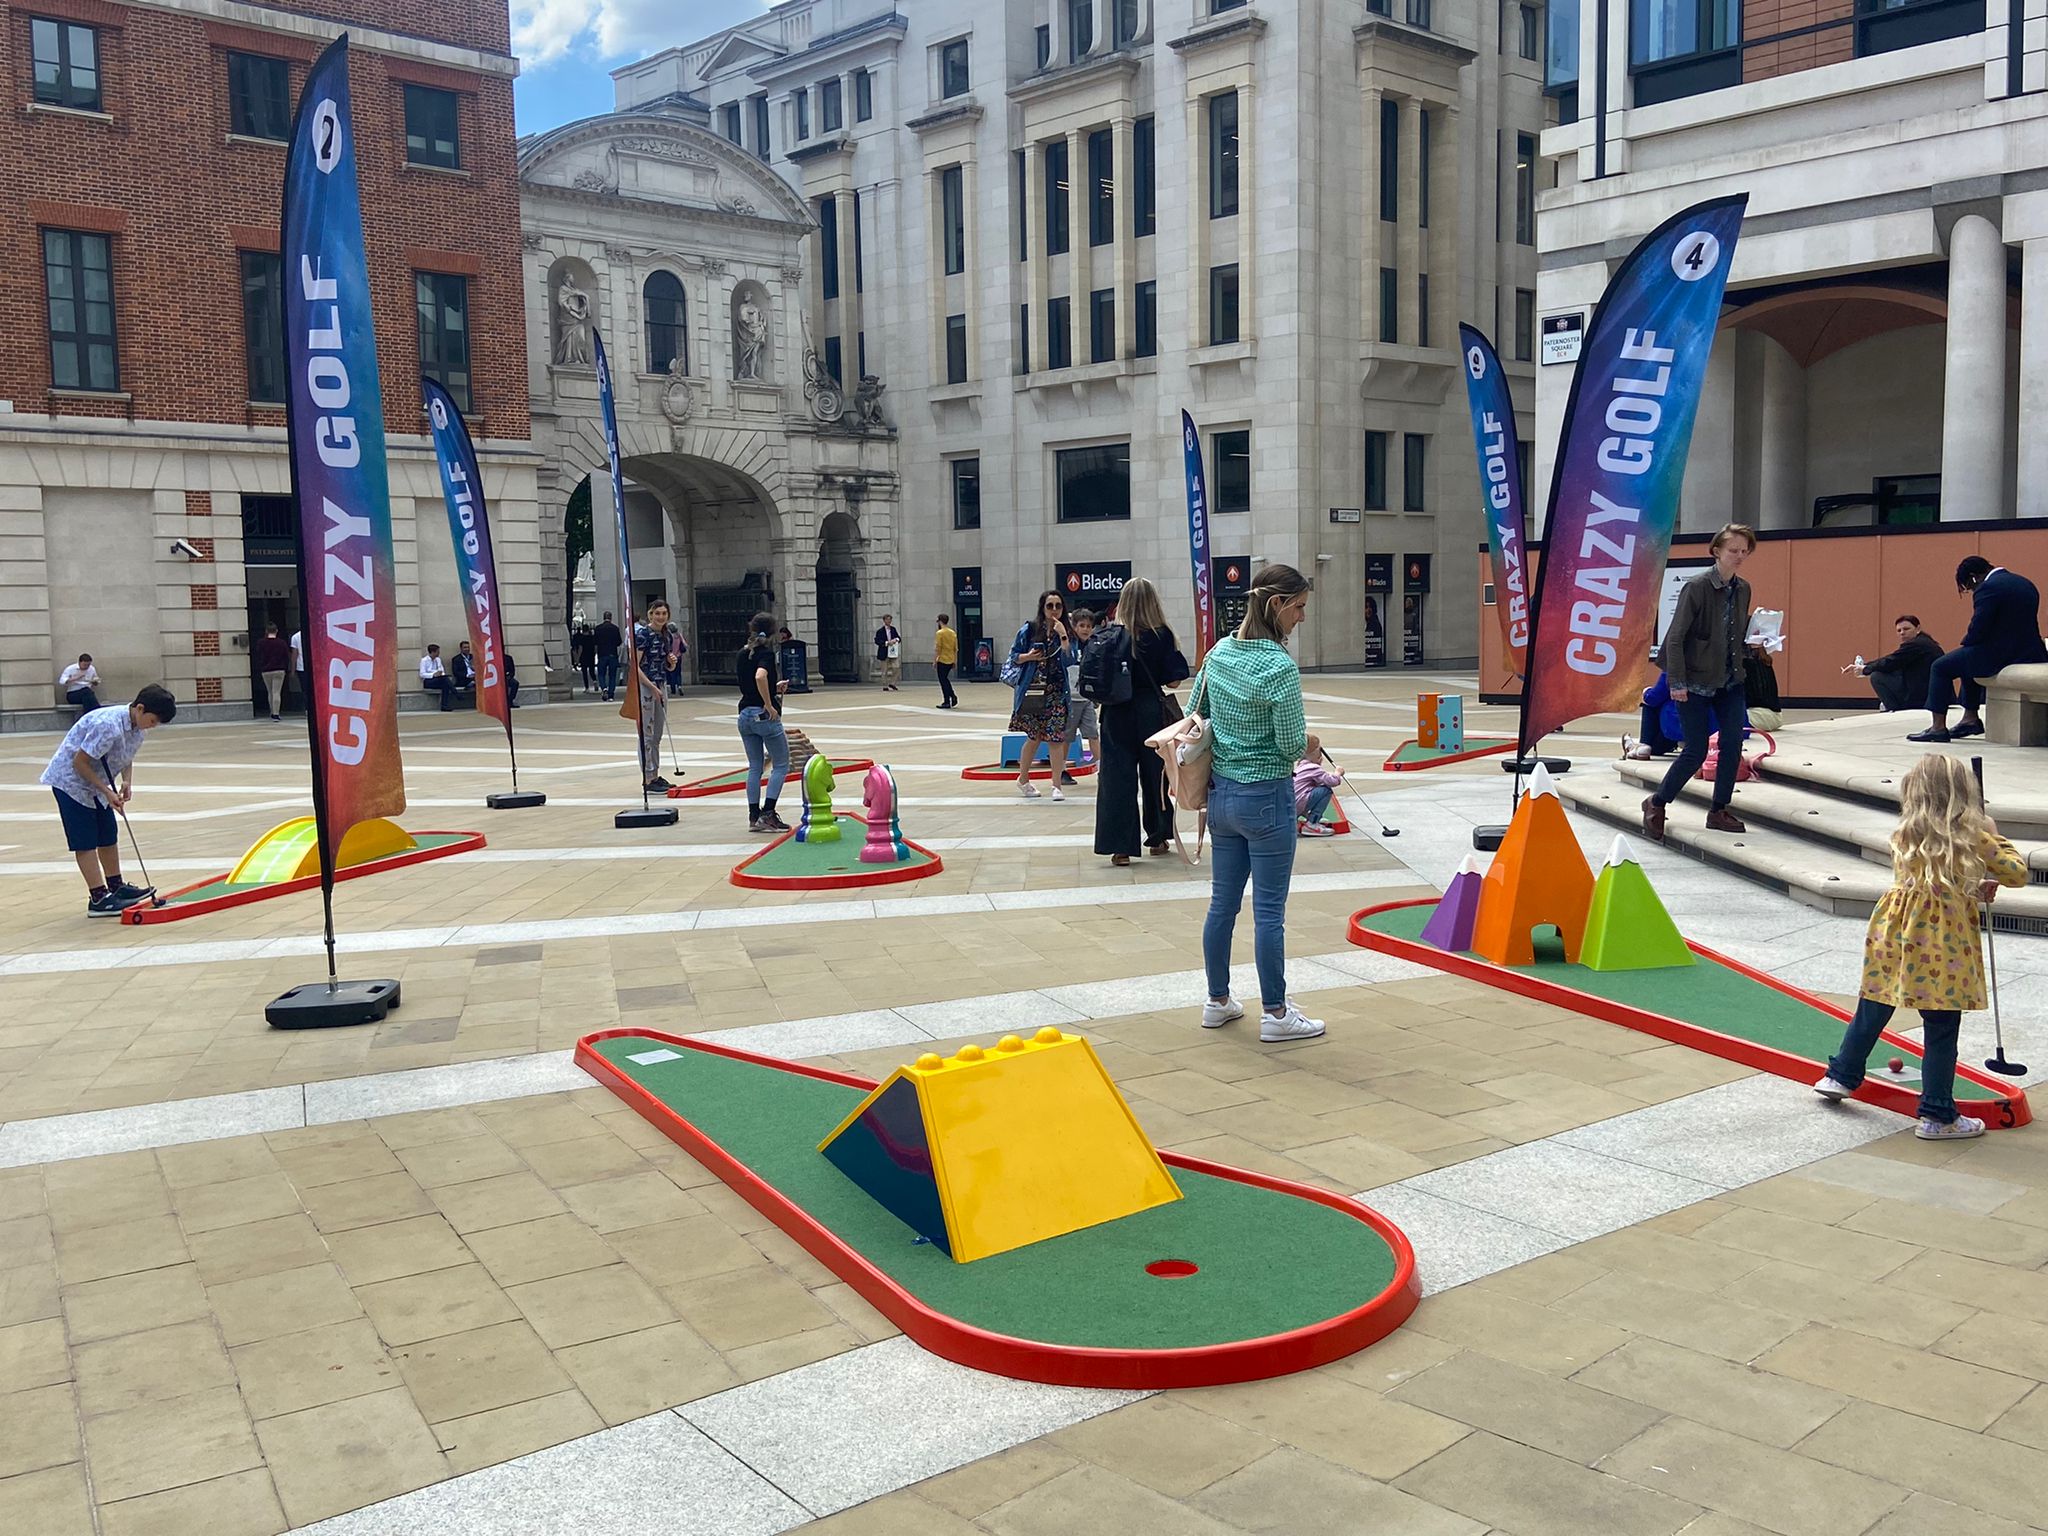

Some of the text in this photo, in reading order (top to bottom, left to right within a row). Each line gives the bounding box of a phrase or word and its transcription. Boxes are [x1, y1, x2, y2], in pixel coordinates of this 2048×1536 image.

[320, 115, 335, 160] 2
[1684, 241, 1704, 271] 4
[1544, 336, 1580, 346] PATERNOSTER
[1551, 344, 1573, 352] SQUARE
[301, 253, 375, 766] CRAZY GOLF
[447, 461, 479, 556] GOLF
[1565, 327, 1675, 677] CRAZY GOLF
[1482, 411, 1530, 648] CRAZY GOLF
[1082, 573, 1123, 590] Blacks
[1194, 559, 1209, 649] AZY
[1994, 1099, 2016, 1128] 3
